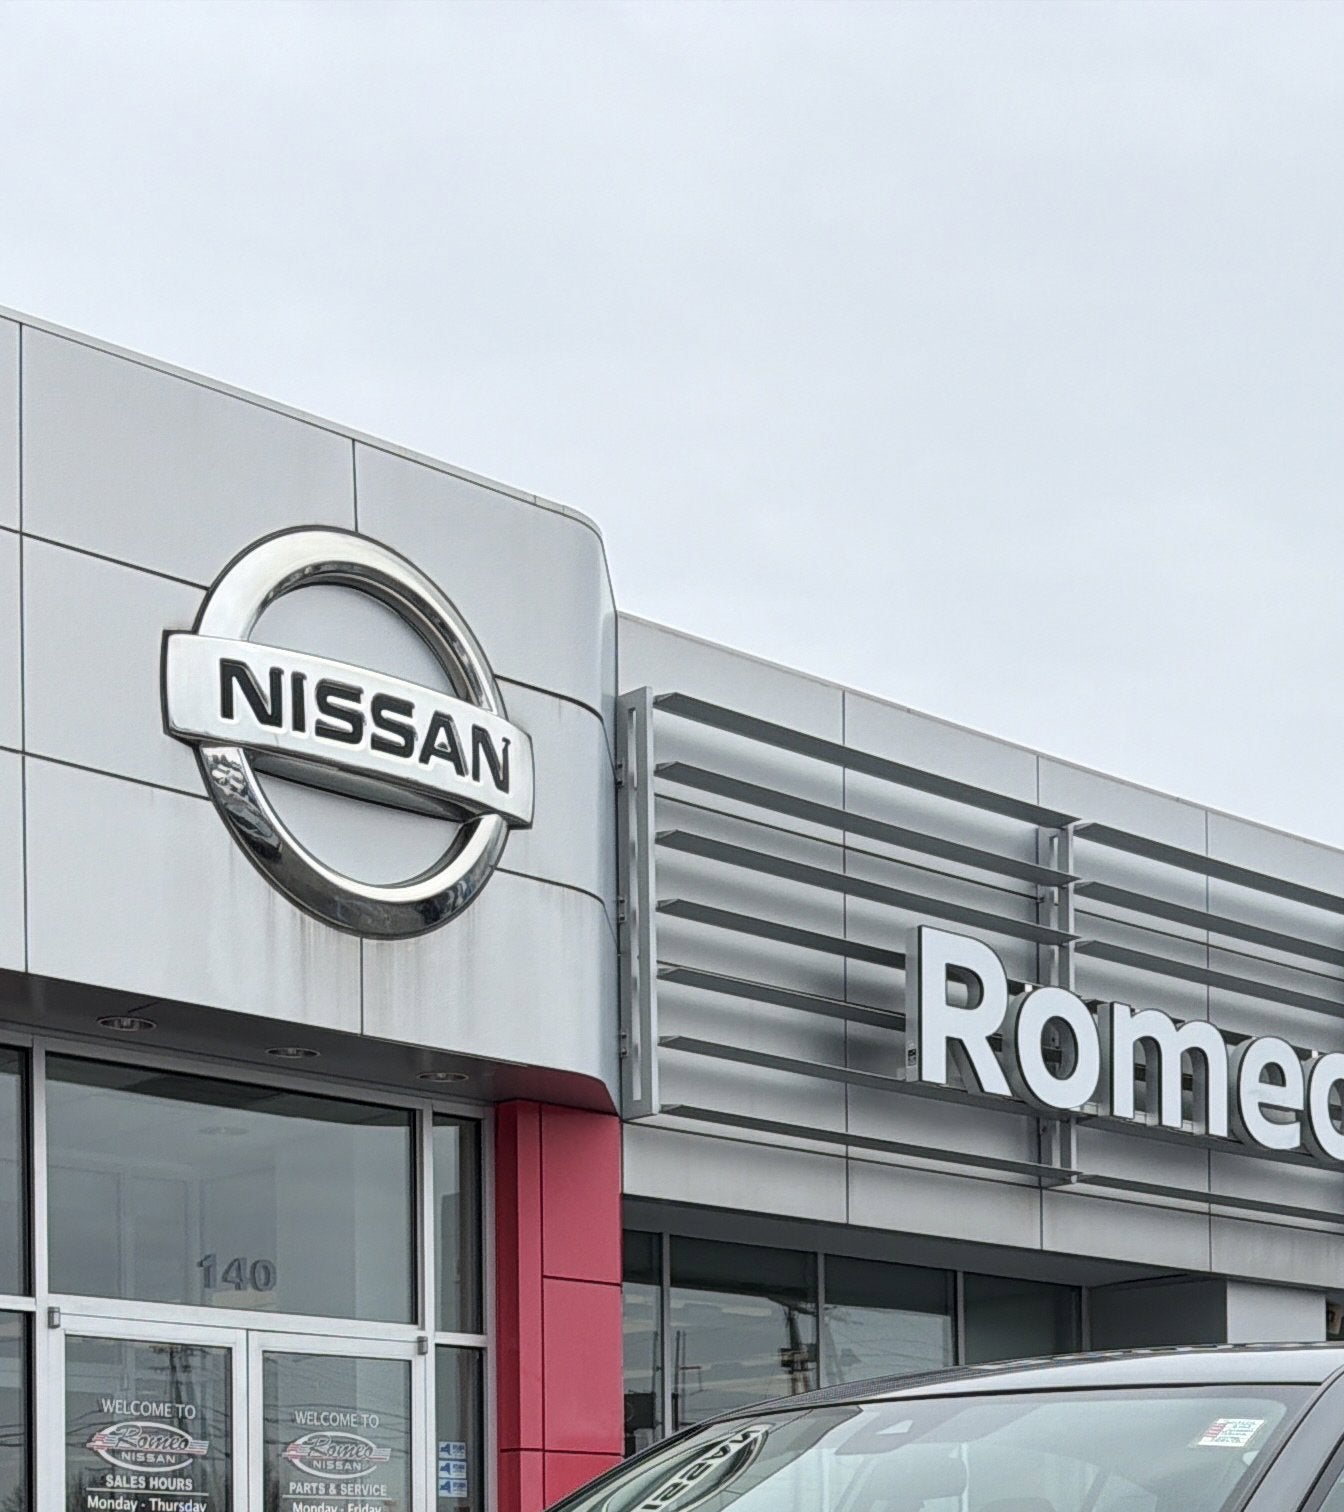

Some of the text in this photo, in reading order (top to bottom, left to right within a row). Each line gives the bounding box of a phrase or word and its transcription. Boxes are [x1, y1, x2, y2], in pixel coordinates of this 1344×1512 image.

[218, 656, 513, 796] NISSAN
[197, 1253, 277, 1292] 140
[101, 1398, 197, 1420] WELCOME TO
[295, 1410, 380, 1429] WELCOME TO
[114, 1424, 190, 1450] Romeo
[304, 1434, 373, 1459] Romeo
[121, 1451, 176, 1464] NISSAN
[312, 1460, 362, 1471] NISSAN
[105, 1473, 193, 1491] SALES HOURS
[289, 1481, 387, 1496] PARTS & SERVICE
[87, 1495, 138, 1512] Monday
